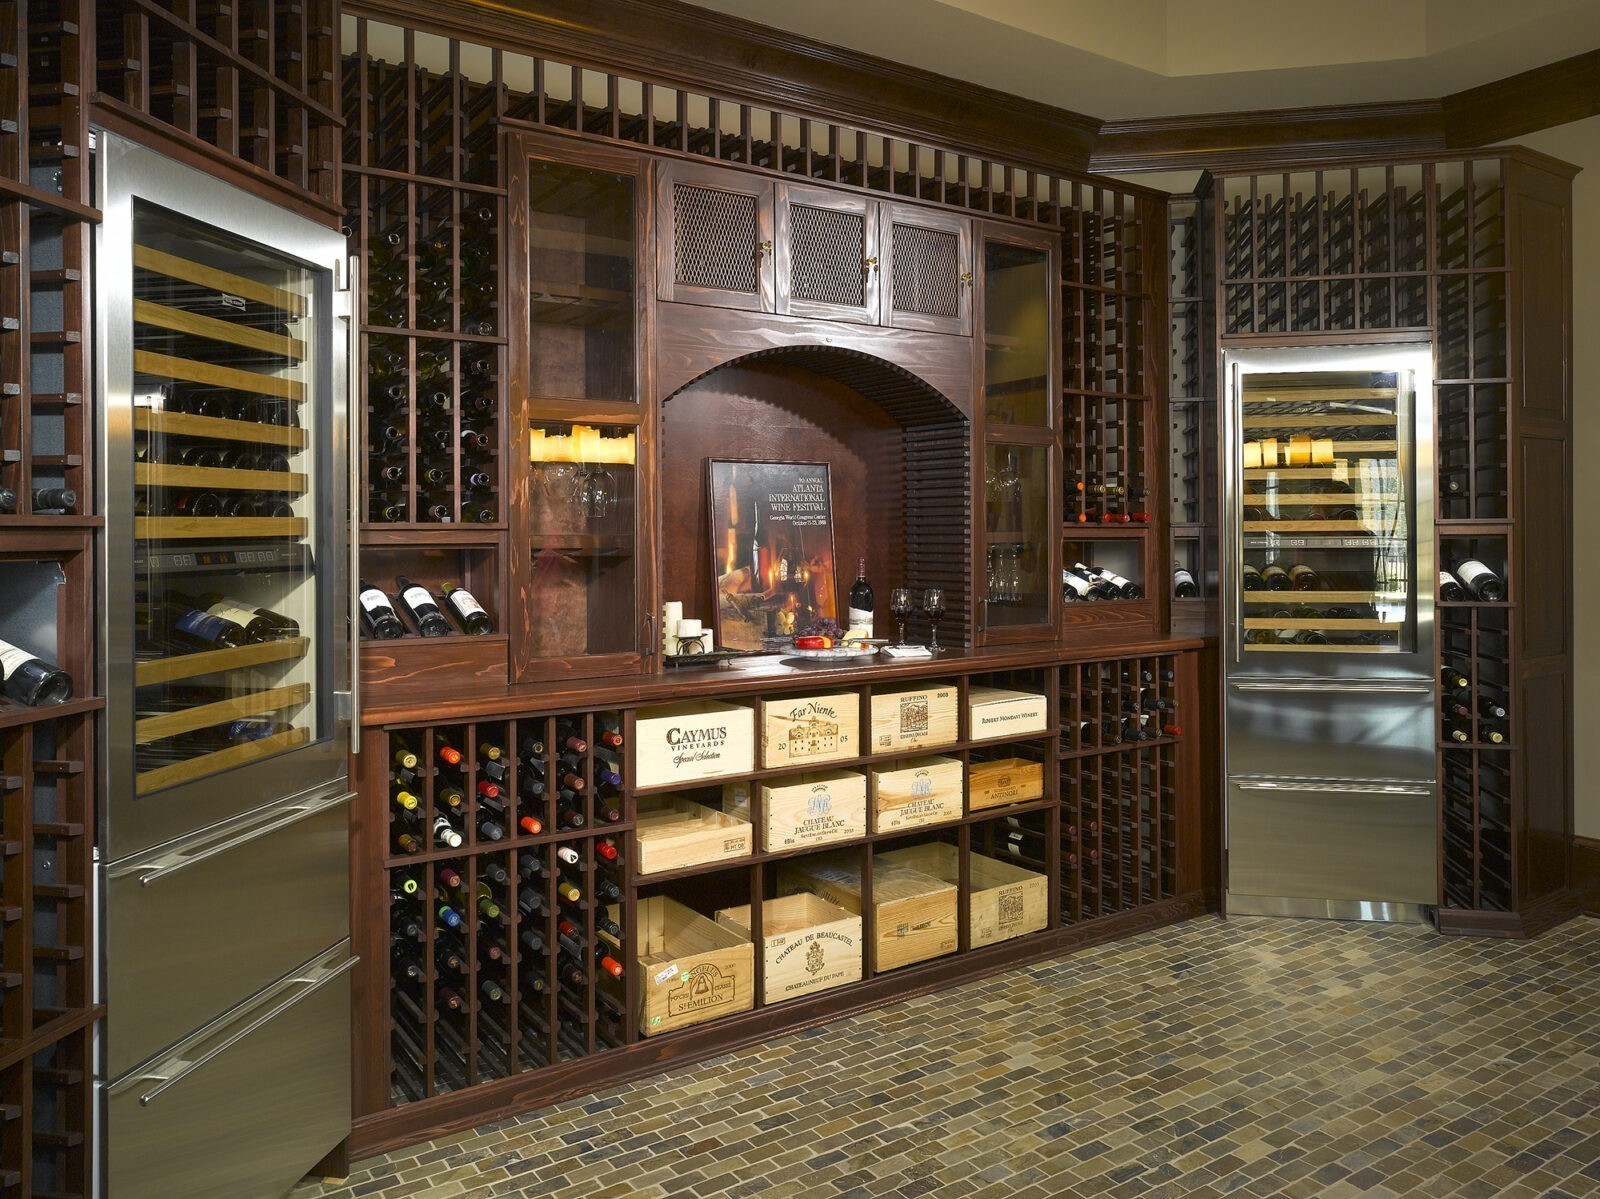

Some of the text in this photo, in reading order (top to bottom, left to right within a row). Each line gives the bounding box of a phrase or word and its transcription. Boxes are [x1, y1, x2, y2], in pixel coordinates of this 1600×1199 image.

[792, 484, 824, 493] ATLANTA
[768, 493, 825, 502] INTERNATIONAL
[771, 502, 826, 511] WINE FESTIVAL
[790, 702, 837, 722] Far Niente
[1021, 711, 1038, 719] WINERY
[666, 727, 727, 745] CAYMUS
[671, 740, 725, 751] VINEYARDS
[672, 750, 721, 768] Special Selection
[990, 788, 1018, 800] ANTINORI
[900, 806, 922, 817] JAUGUE
[924, 802, 944, 812] BLANC
[794, 824, 821, 835] JAUGUE
[822, 819, 845, 831] BLANC
[998, 885, 1023, 896] RUFFINO
[775, 939, 803, 965] CHATEAU
[805, 934, 815, 943] DE
[816, 931, 853, 947] BEAUCASTEL
[785, 971, 845, 991] CHATEAUNEUF DU PAPE
